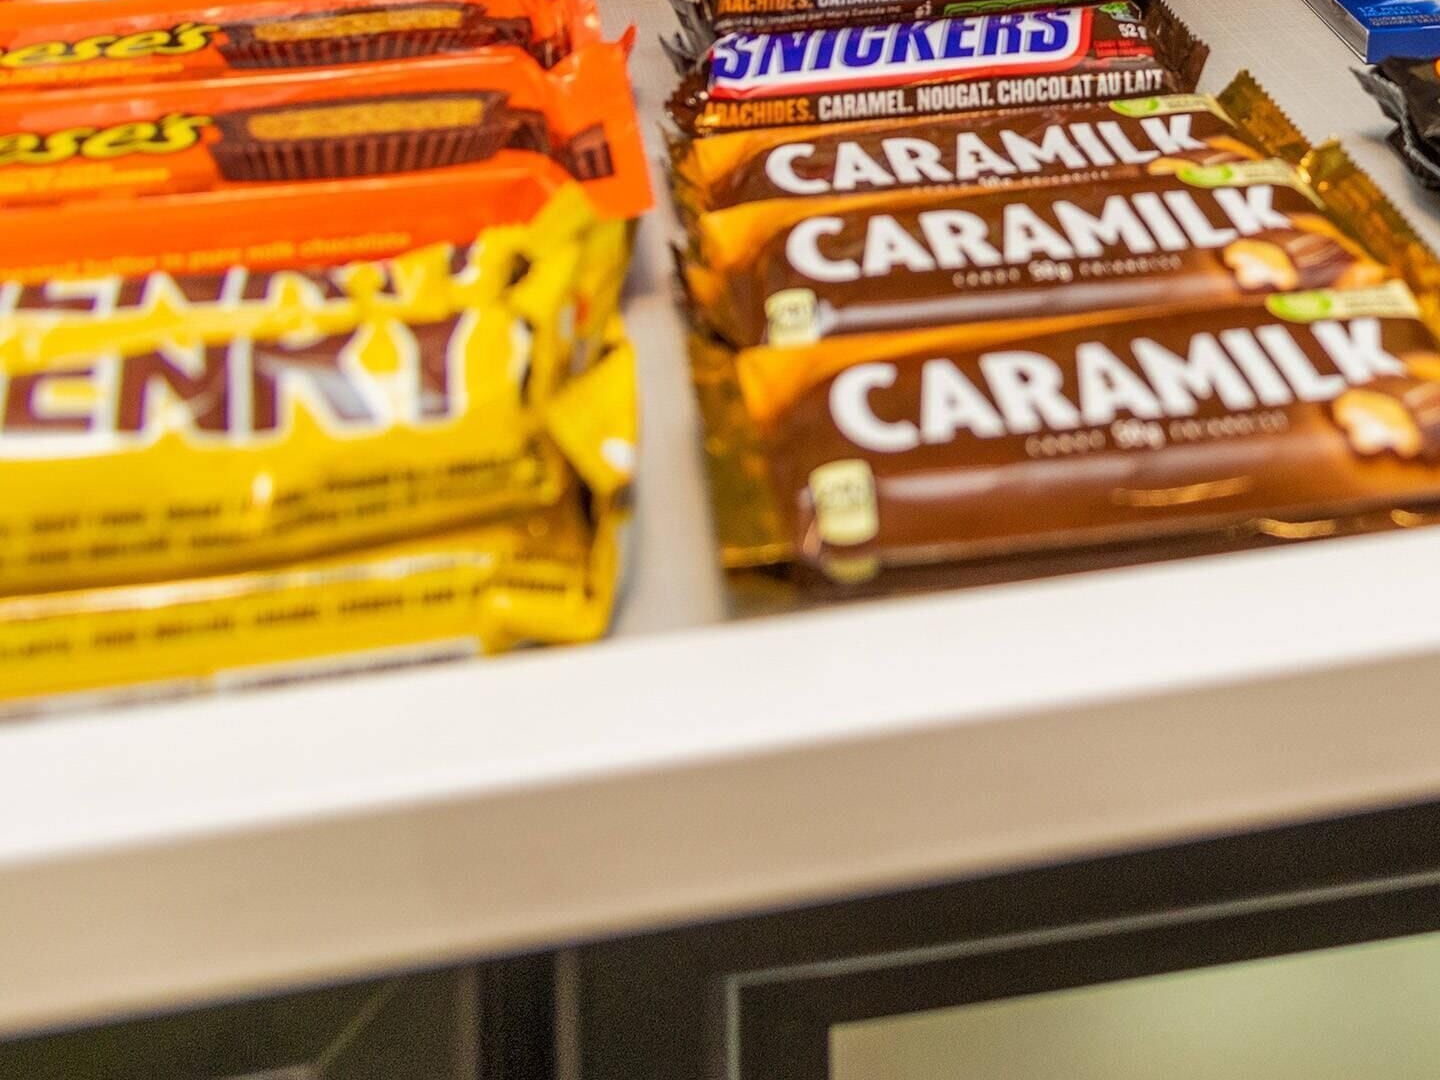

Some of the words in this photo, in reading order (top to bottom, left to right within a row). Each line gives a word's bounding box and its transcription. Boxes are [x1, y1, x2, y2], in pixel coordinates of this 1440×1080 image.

[713, 8, 1069, 79] SNICKERS
[818, 88, 914, 121] CARAMEL.
[916, 82, 994, 112] NOUGAT.
[997, 73, 1096, 104] CHOCOLAT
[1098, 72, 1121, 95] AU
[1124, 68, 1164, 93] LAIT
[766, 113, 1206, 195] CARAMILK
[786, 184, 1291, 284] CARAMILK
[829, 318, 1407, 454] CARAMILK
